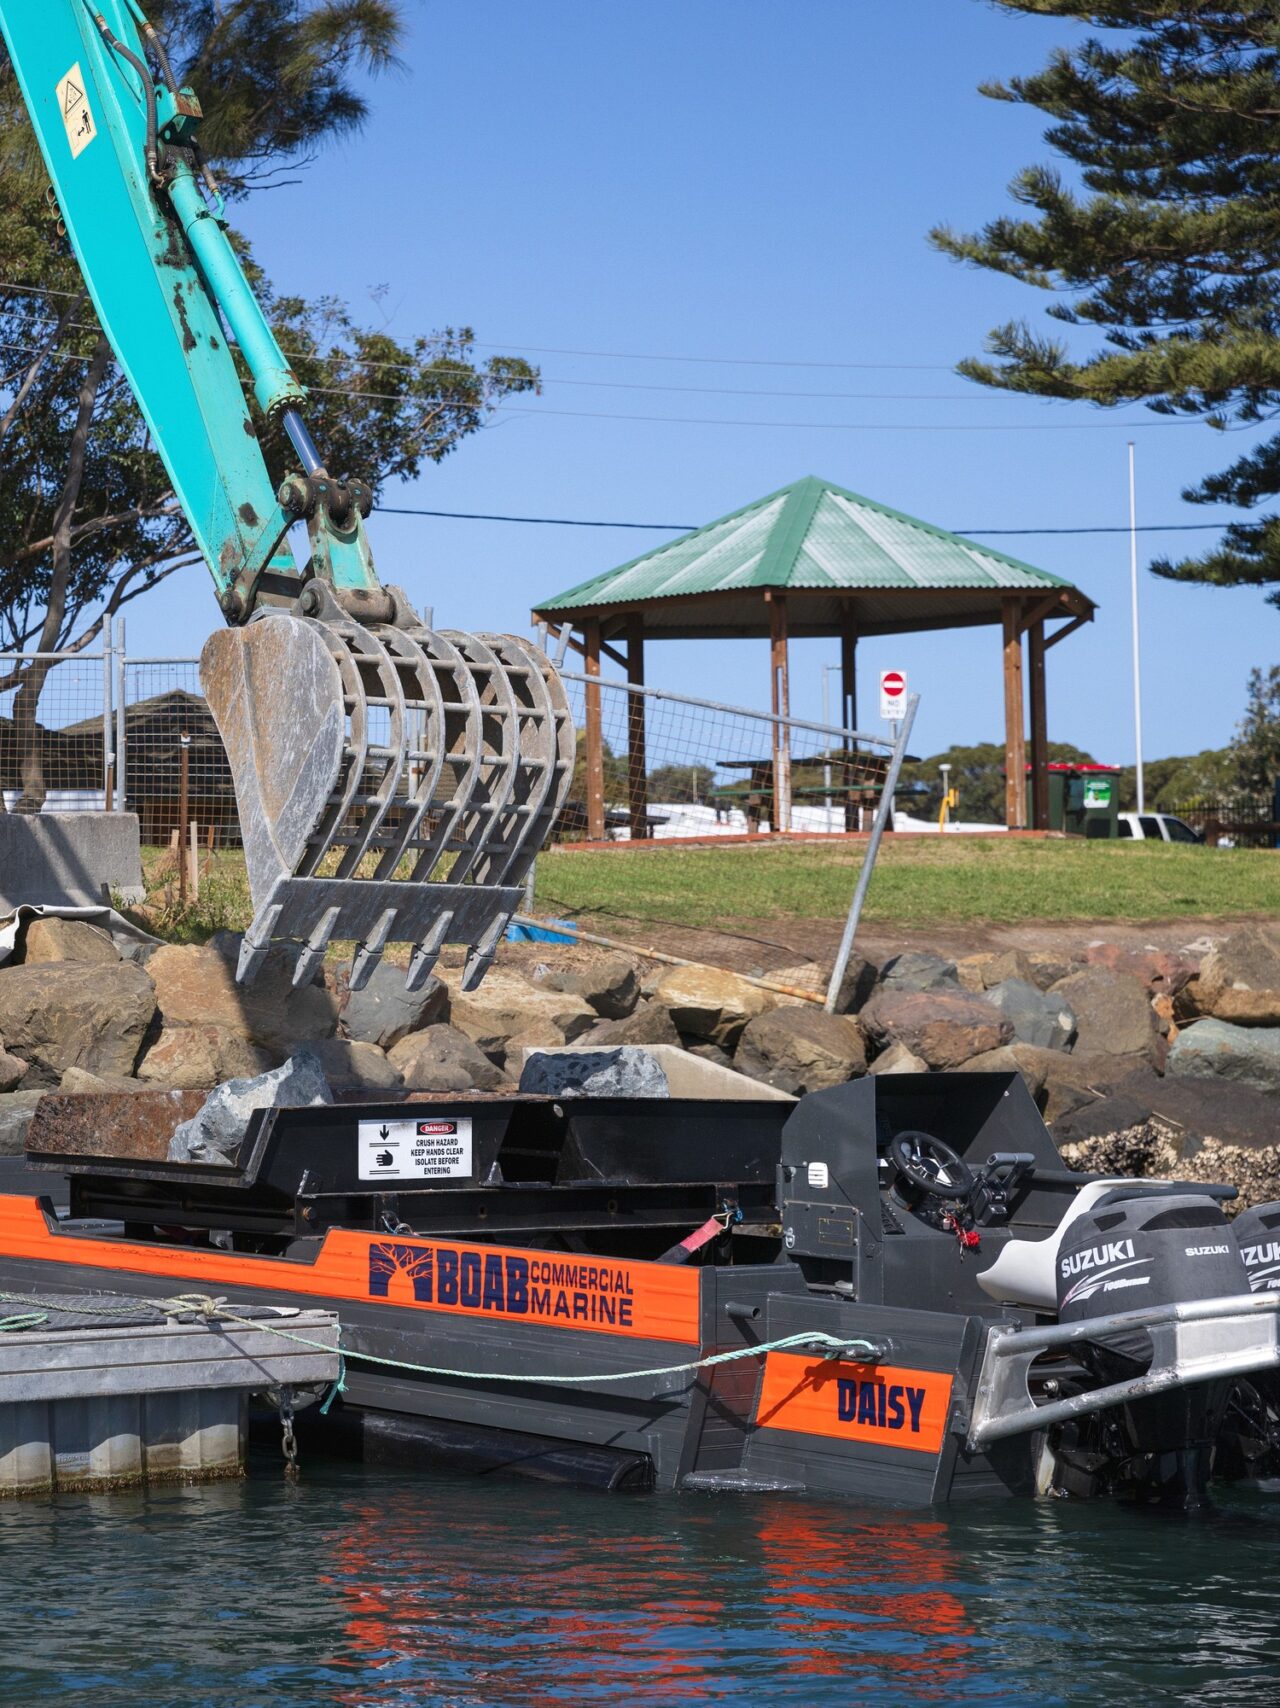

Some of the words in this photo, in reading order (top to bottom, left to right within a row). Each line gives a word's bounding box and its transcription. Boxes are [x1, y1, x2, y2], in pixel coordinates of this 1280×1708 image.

[411, 1149, 425, 1157] KEEP
[426, 1148, 444, 1156] HANDS
[446, 1147, 464, 1155] CLEAR
[416, 1139, 435, 1147] CRUSH
[436, 1138, 458, 1146] HAZARD
[415, 1158, 437, 1166] ISOLATE
[438, 1157, 460, 1165] BEFORE
[424, 1167, 451, 1175] ENTERING
[1061, 1239, 1135, 1279] SUZUKI
[1184, 1245, 1230, 1256] SUZUKI
[436, 1249, 529, 1314] BOAB
[530, 1260, 634, 1295] COMMERCIAL
[531, 1287, 633, 1327] MARINE
[837, 1378, 926, 1433] DAISY
